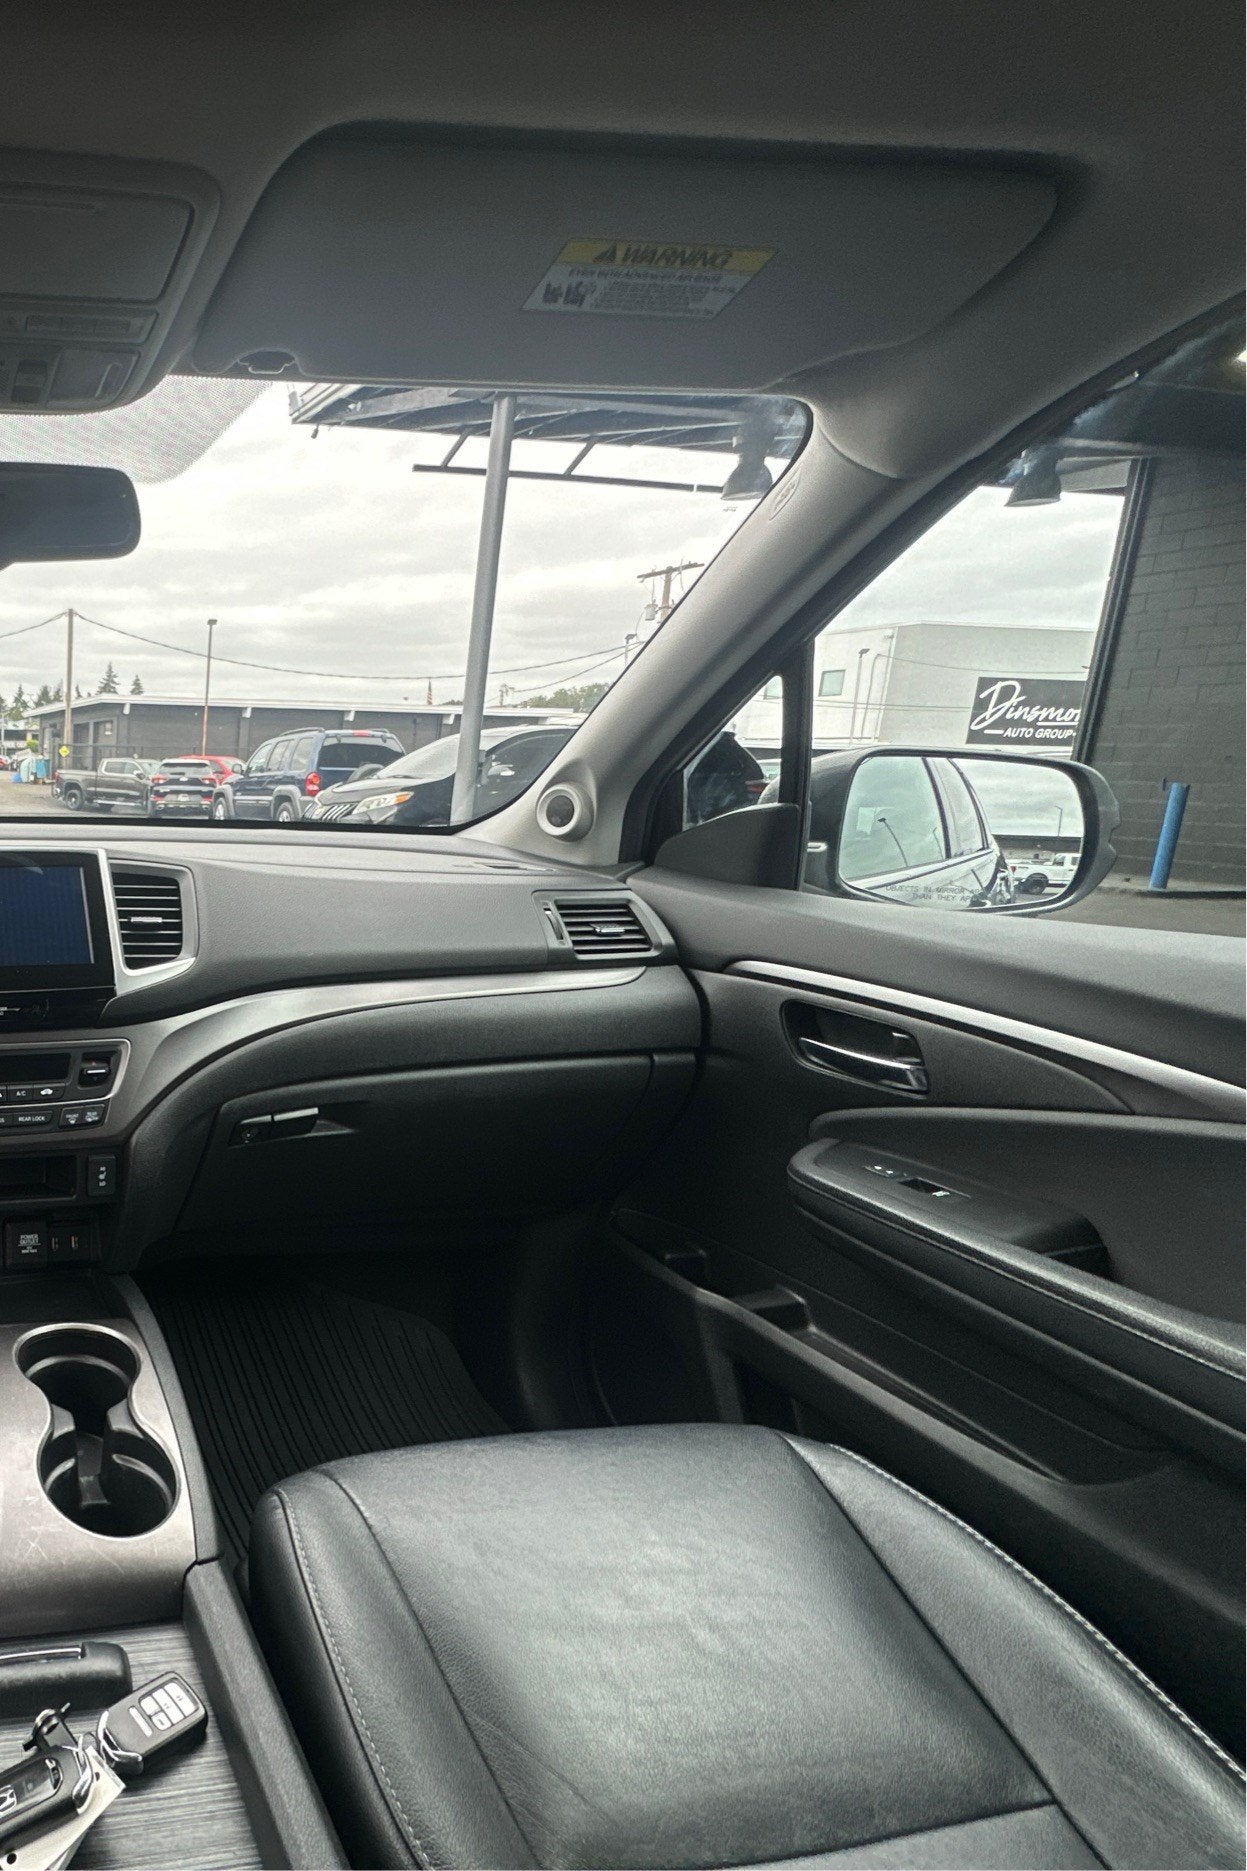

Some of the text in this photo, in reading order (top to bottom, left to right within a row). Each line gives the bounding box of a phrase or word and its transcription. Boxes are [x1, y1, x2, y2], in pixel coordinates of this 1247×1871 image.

[621, 246, 733, 268] WARNING
[970, 680, 1082, 730] Dinsmor
[1003, 727, 1073, 739] AUTO GROUP
[885, 884, 919, 893] OBJECTS
[934, 887, 965, 895] MIRROR
